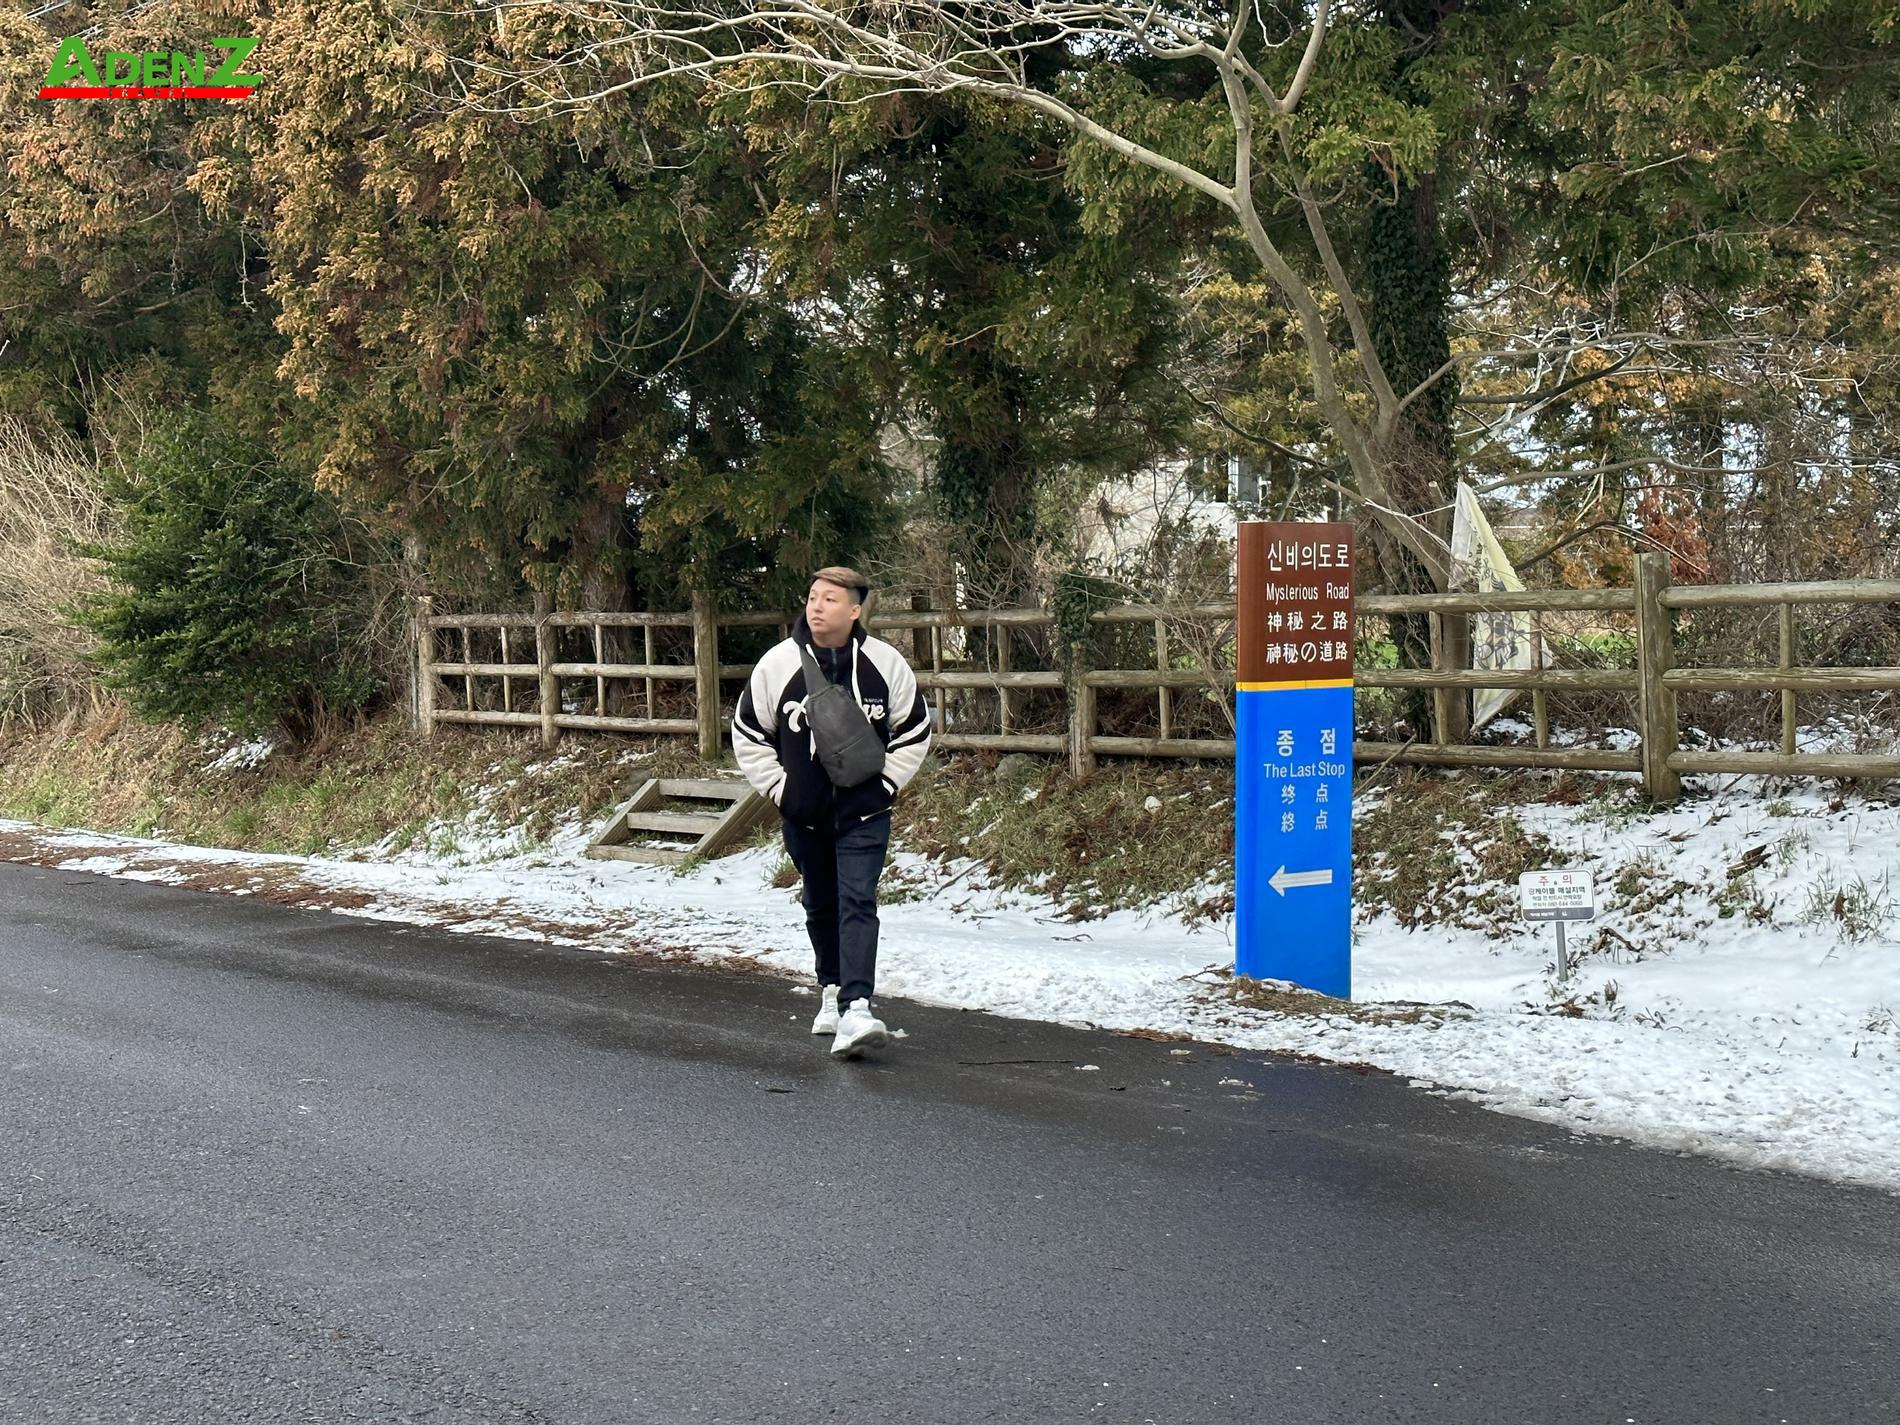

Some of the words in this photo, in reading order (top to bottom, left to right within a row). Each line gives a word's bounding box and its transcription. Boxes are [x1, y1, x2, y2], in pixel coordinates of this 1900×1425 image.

[1267, 540, 1350, 571] 신비의도로
[1266, 583, 1319, 605] Mysterious
[1326, 582, 1350, 600] Road
[1267, 610, 1348, 632] 神秘之路
[1266, 640, 1348, 664] 神秘の道路
[1264, 763, 1288, 778] The
[1290, 762, 1316, 778] Last
[1318, 761, 1345, 778] Stop
